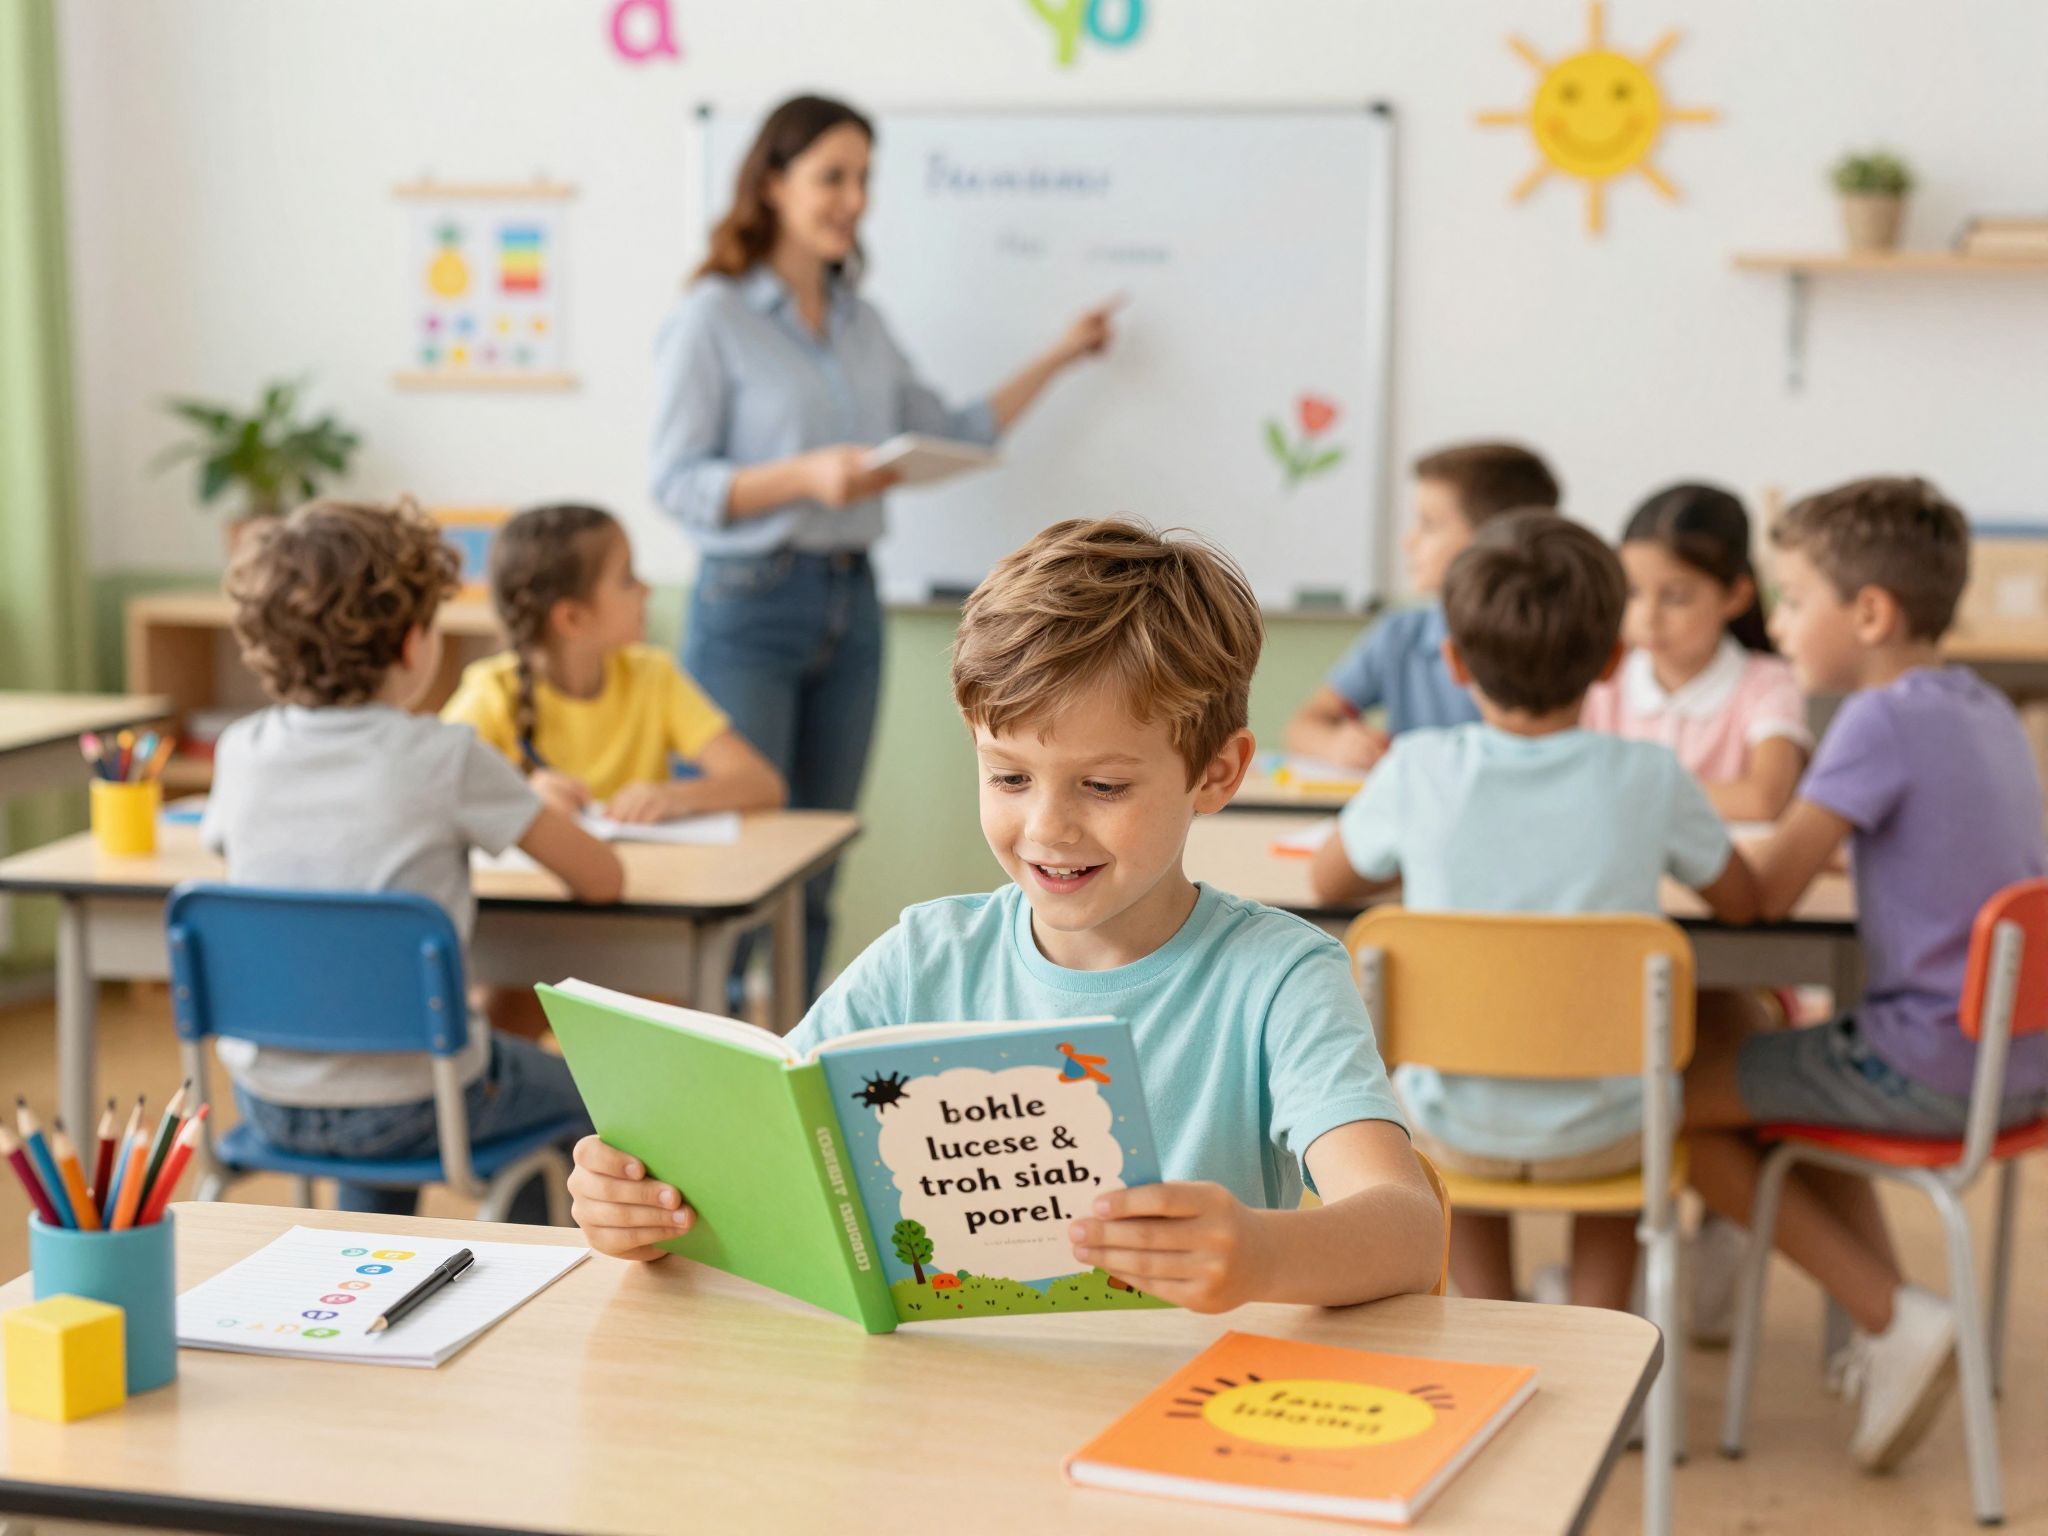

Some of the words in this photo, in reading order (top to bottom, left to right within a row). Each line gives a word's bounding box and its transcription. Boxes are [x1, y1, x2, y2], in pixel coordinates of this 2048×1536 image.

[939, 1093, 1046, 1124] bohle
[926, 1135, 1039, 1160] lucese
[1052, 1125, 1078, 1149] &
[919, 1167, 1002, 1196] troh
[1014, 1159, 1101, 1188] siab,
[964, 1196, 1073, 1234] porel.
